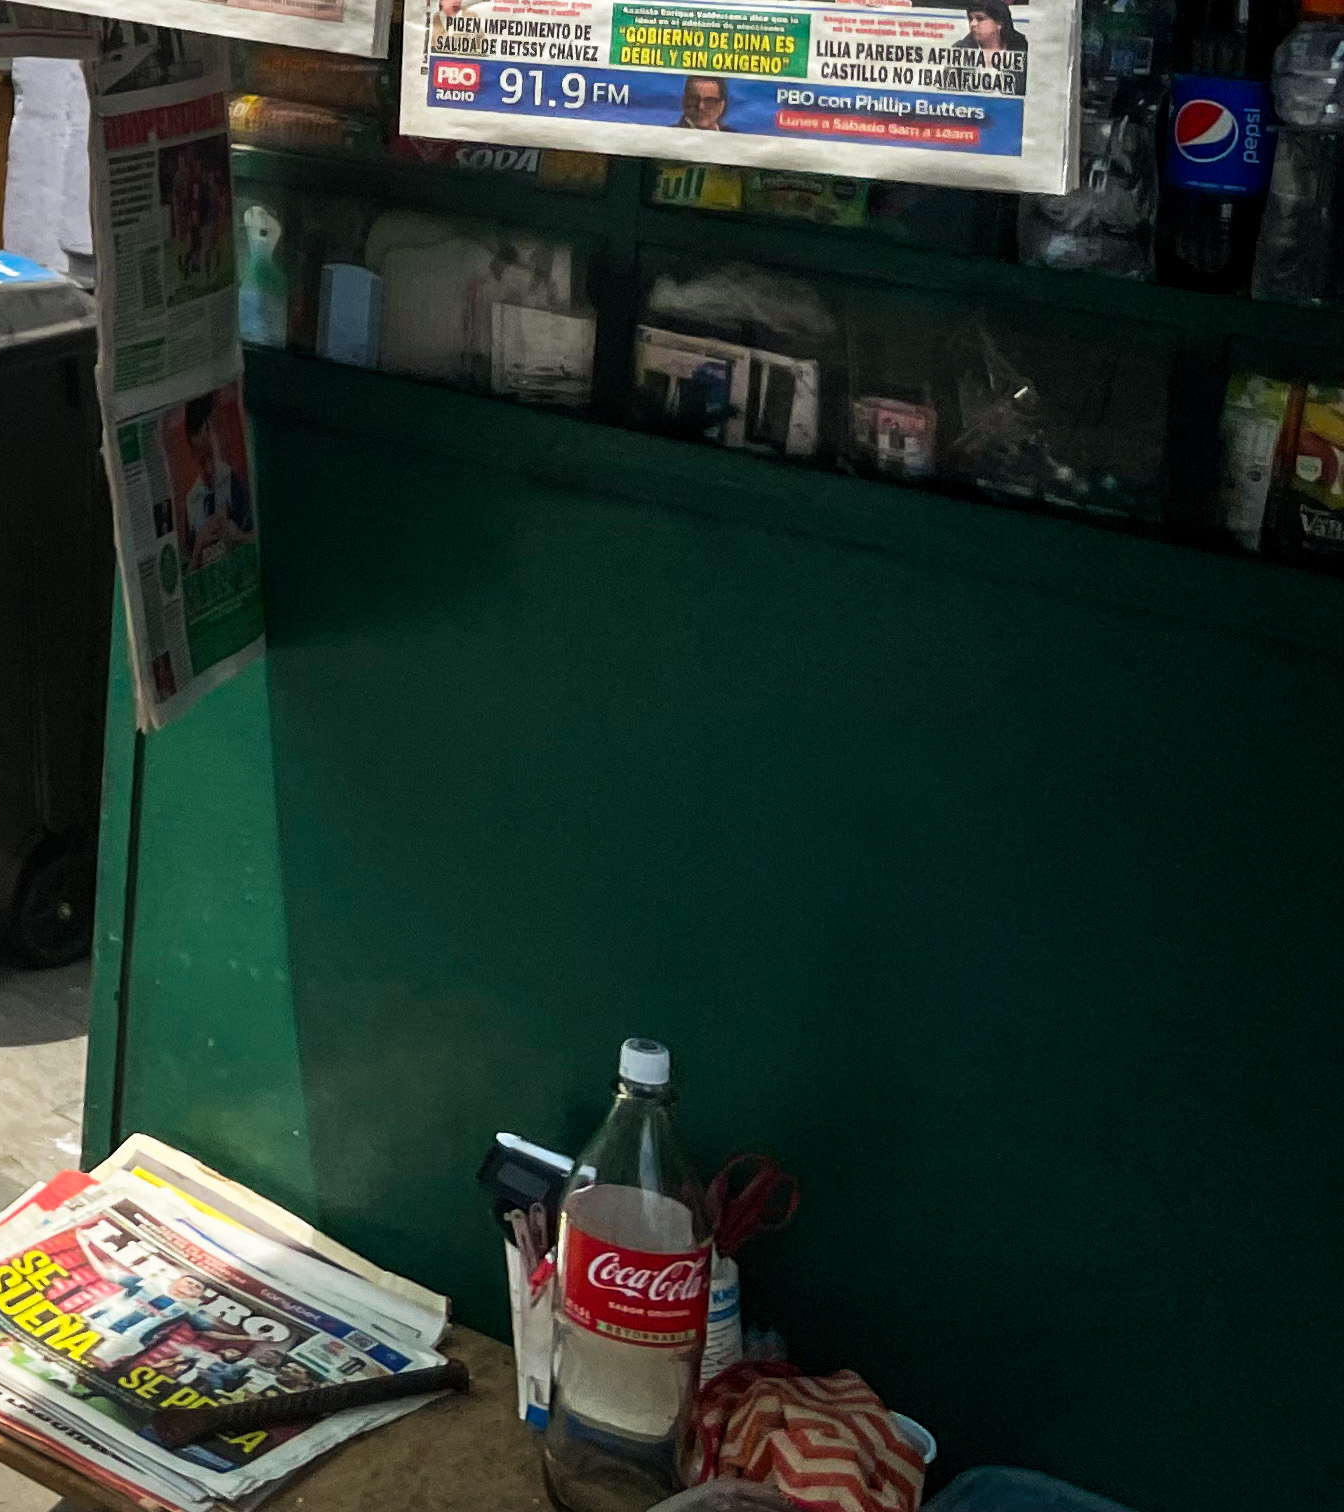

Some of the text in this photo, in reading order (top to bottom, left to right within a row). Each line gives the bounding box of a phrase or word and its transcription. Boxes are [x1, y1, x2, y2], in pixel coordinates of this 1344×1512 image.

[446, 17, 591, 41] PIDEN IMPEDIMENTO DE
[436, 36, 598, 62] SALIDA DE BETSSY CHÁVEZ
[709, 32, 729, 49] DE
[733, 33, 771, 53] DINA
[776, 36, 795, 53] ES
[669, 49, 679, 66] Y
[682, 51, 708, 68] SIN
[437, 65, 479, 86] PBO
[499, 67, 630, 110] 91.9 FM
[435, 89, 475, 102] RADIO
[776, 89, 984, 119] PBO con Phillip Butters
[1243, 108, 1261, 164] pepsi
[455, 148, 542, 173] SODA
[12, 1249, 70, 1291] SE
[587, 1252, 707, 1301] Coca-Cola
[118, 1366, 176, 1399] SE
